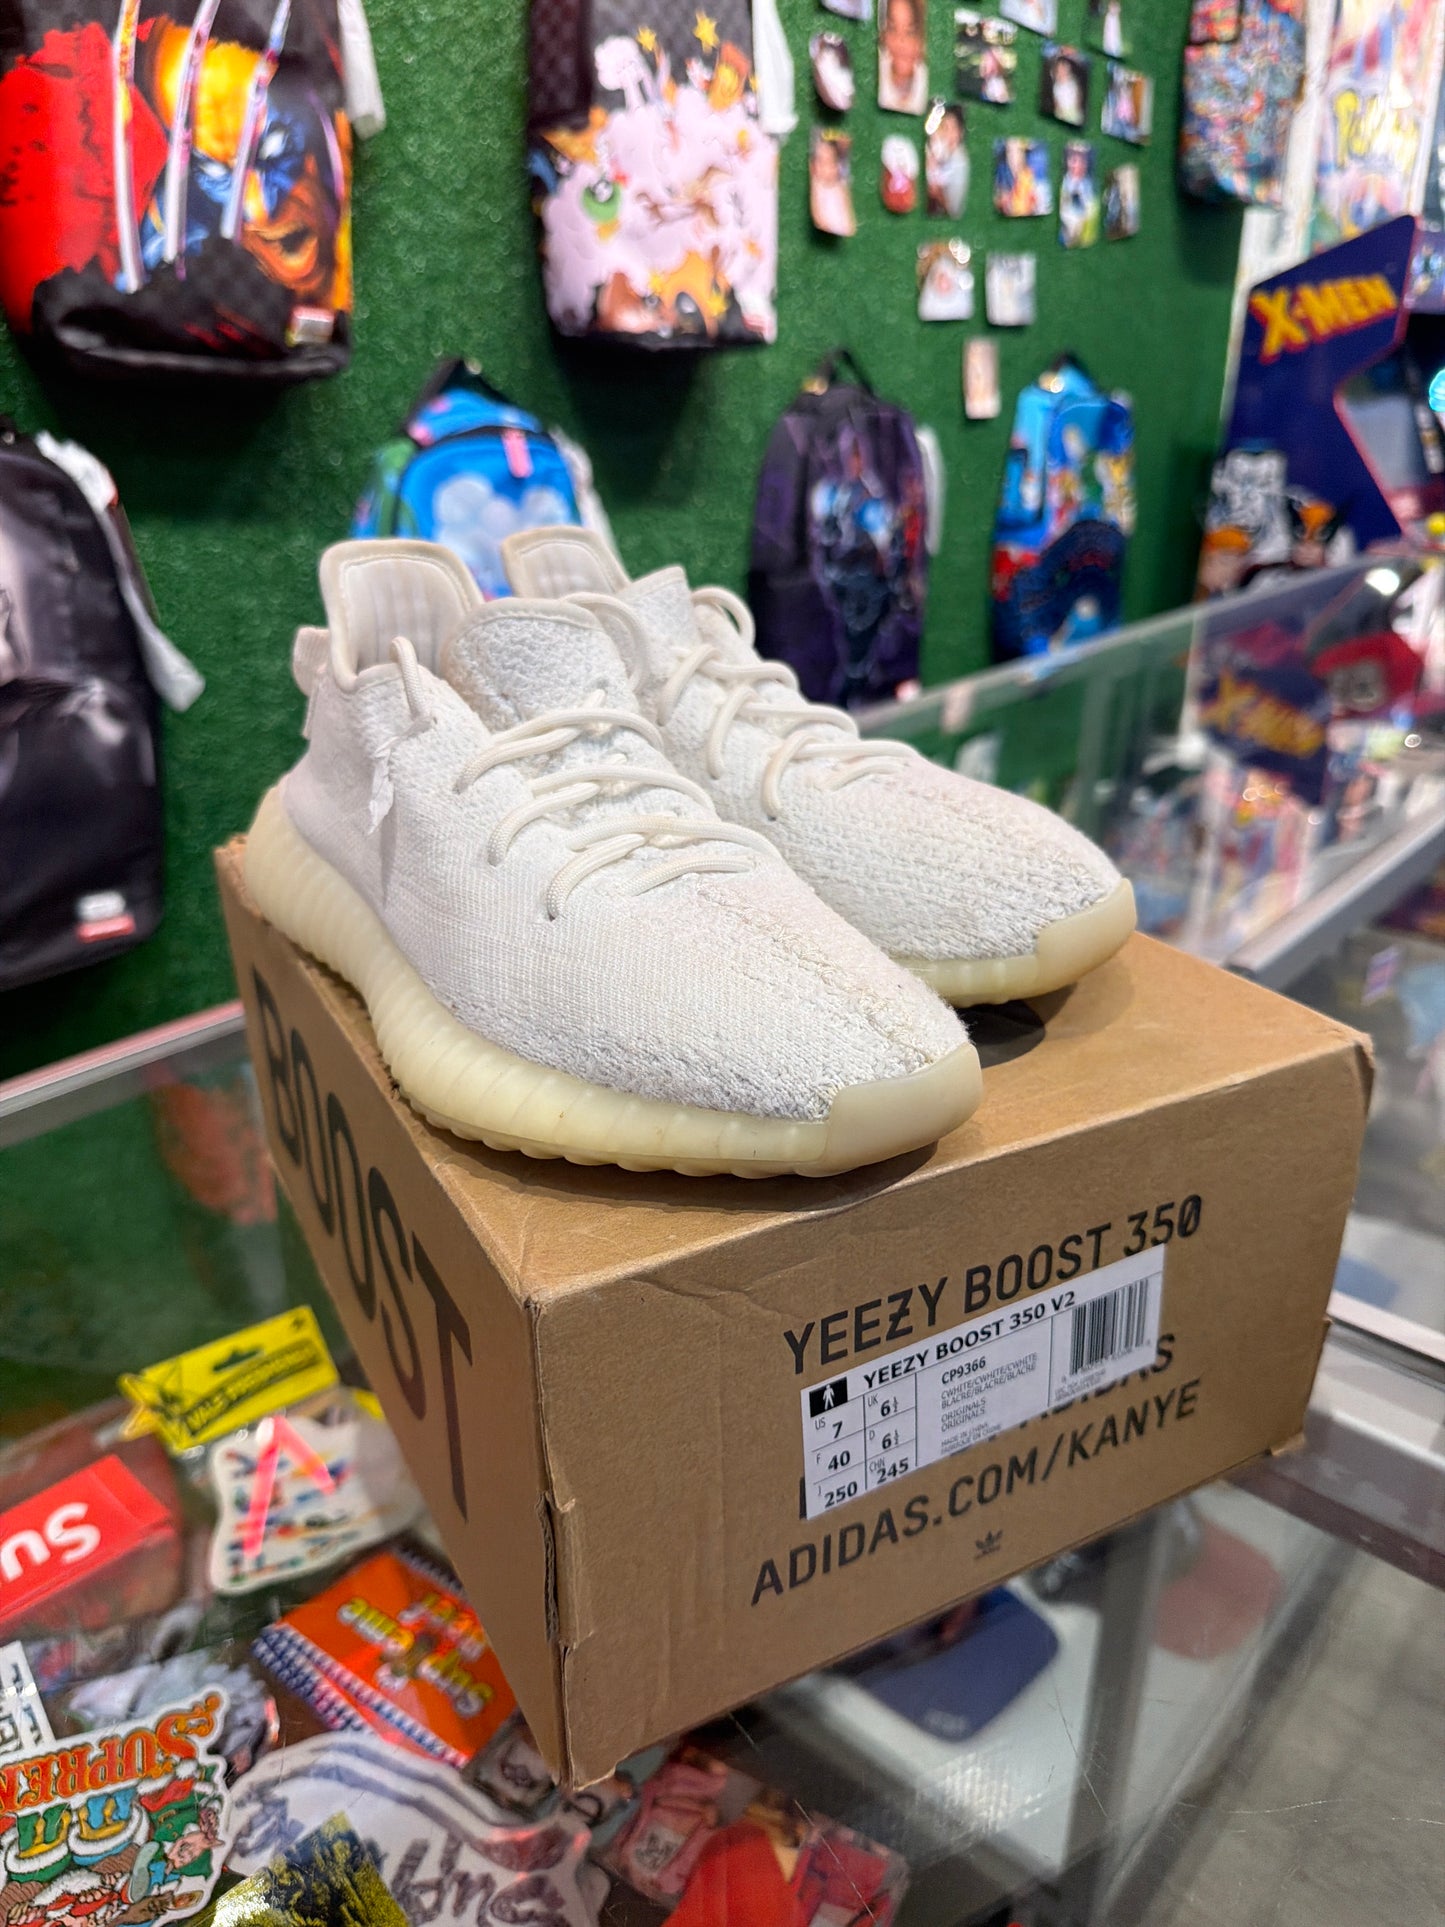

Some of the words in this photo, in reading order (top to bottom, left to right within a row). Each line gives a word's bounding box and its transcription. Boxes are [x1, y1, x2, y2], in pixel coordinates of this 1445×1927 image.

[1249, 274, 1398, 364] X-MEN
[251, 963, 473, 1524] BOOST
[783, 1277, 948, 1375] YEEZY
[964, 1222, 1112, 1315] BOOST
[1122, 1194, 1202, 1257] 350
[863, 1350, 928, 1389] YEEZY
[935, 1318, 1003, 1360] BOOST
[1008, 1302, 1046, 1330] 350
[1050, 1290, 1076, 1312] V2
[940, 1355, 987, 1385] CP9366
[867, 1393, 879, 1408] UK
[940, 1396, 987, 1423] ORIGINALS
[814, 1417, 826, 1431] US
[832, 1420, 843, 1439] 7
[940, 1405, 987, 1433] ORIGINALS
[816, 1453, 821, 1465] F
[827, 1449, 851, 1471] 40
[876, 1456, 909, 1485] 245
[751, 1378, 1200, 1607] ADIDAS.COM/KANYE
[823, 1480, 858, 1508] 250
